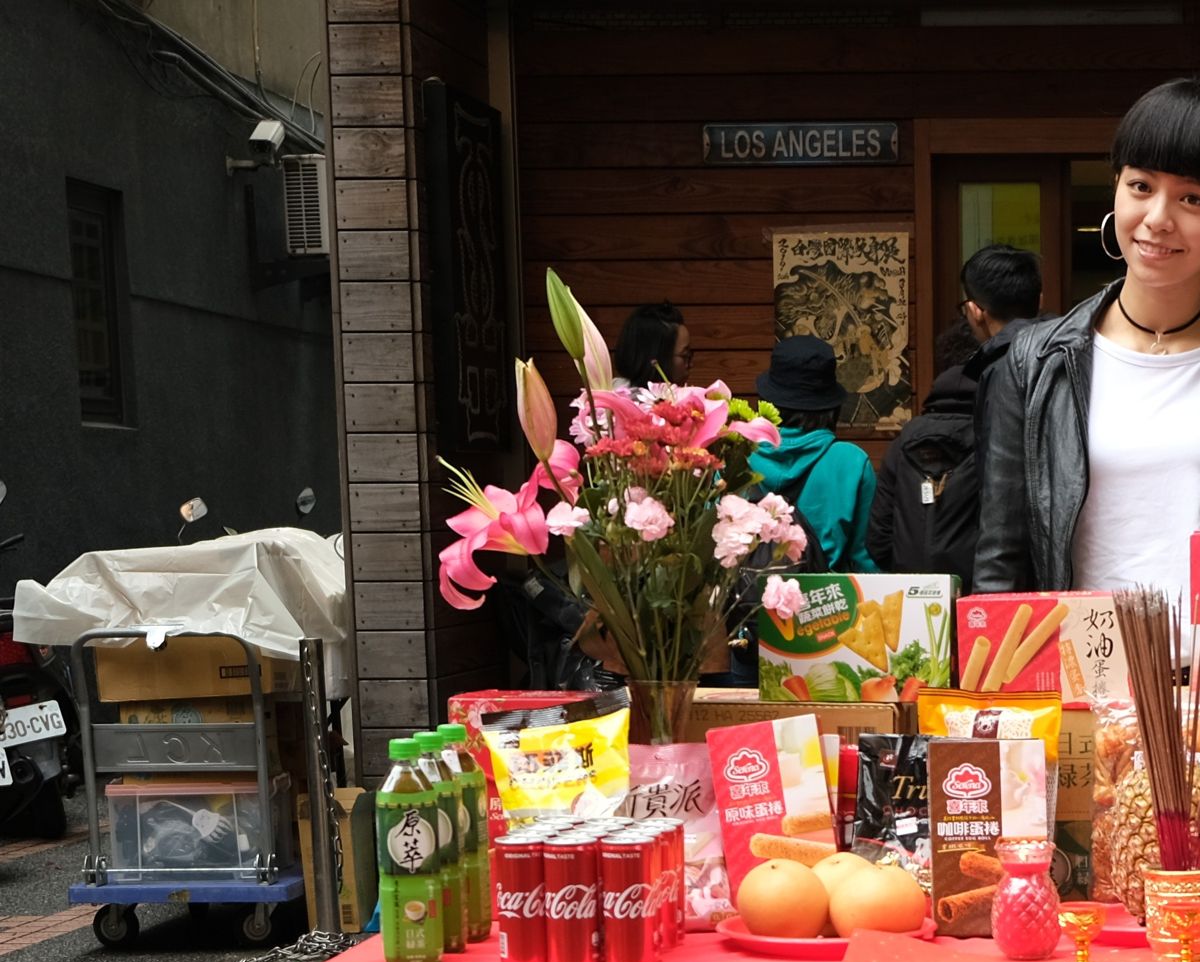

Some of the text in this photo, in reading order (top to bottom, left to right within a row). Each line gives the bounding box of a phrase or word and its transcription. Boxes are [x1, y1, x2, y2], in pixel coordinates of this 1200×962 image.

[721, 129, 881, 158] LOS ANGELES
[729, 781, 770, 800] 喜年來
[725, 800, 784, 823] 原味蛋捲
[946, 800, 989, 815] 喜年來
[937, 820, 1001, 837] 咖啡蛋捲
[395, 809, 425, 873] 原萃
